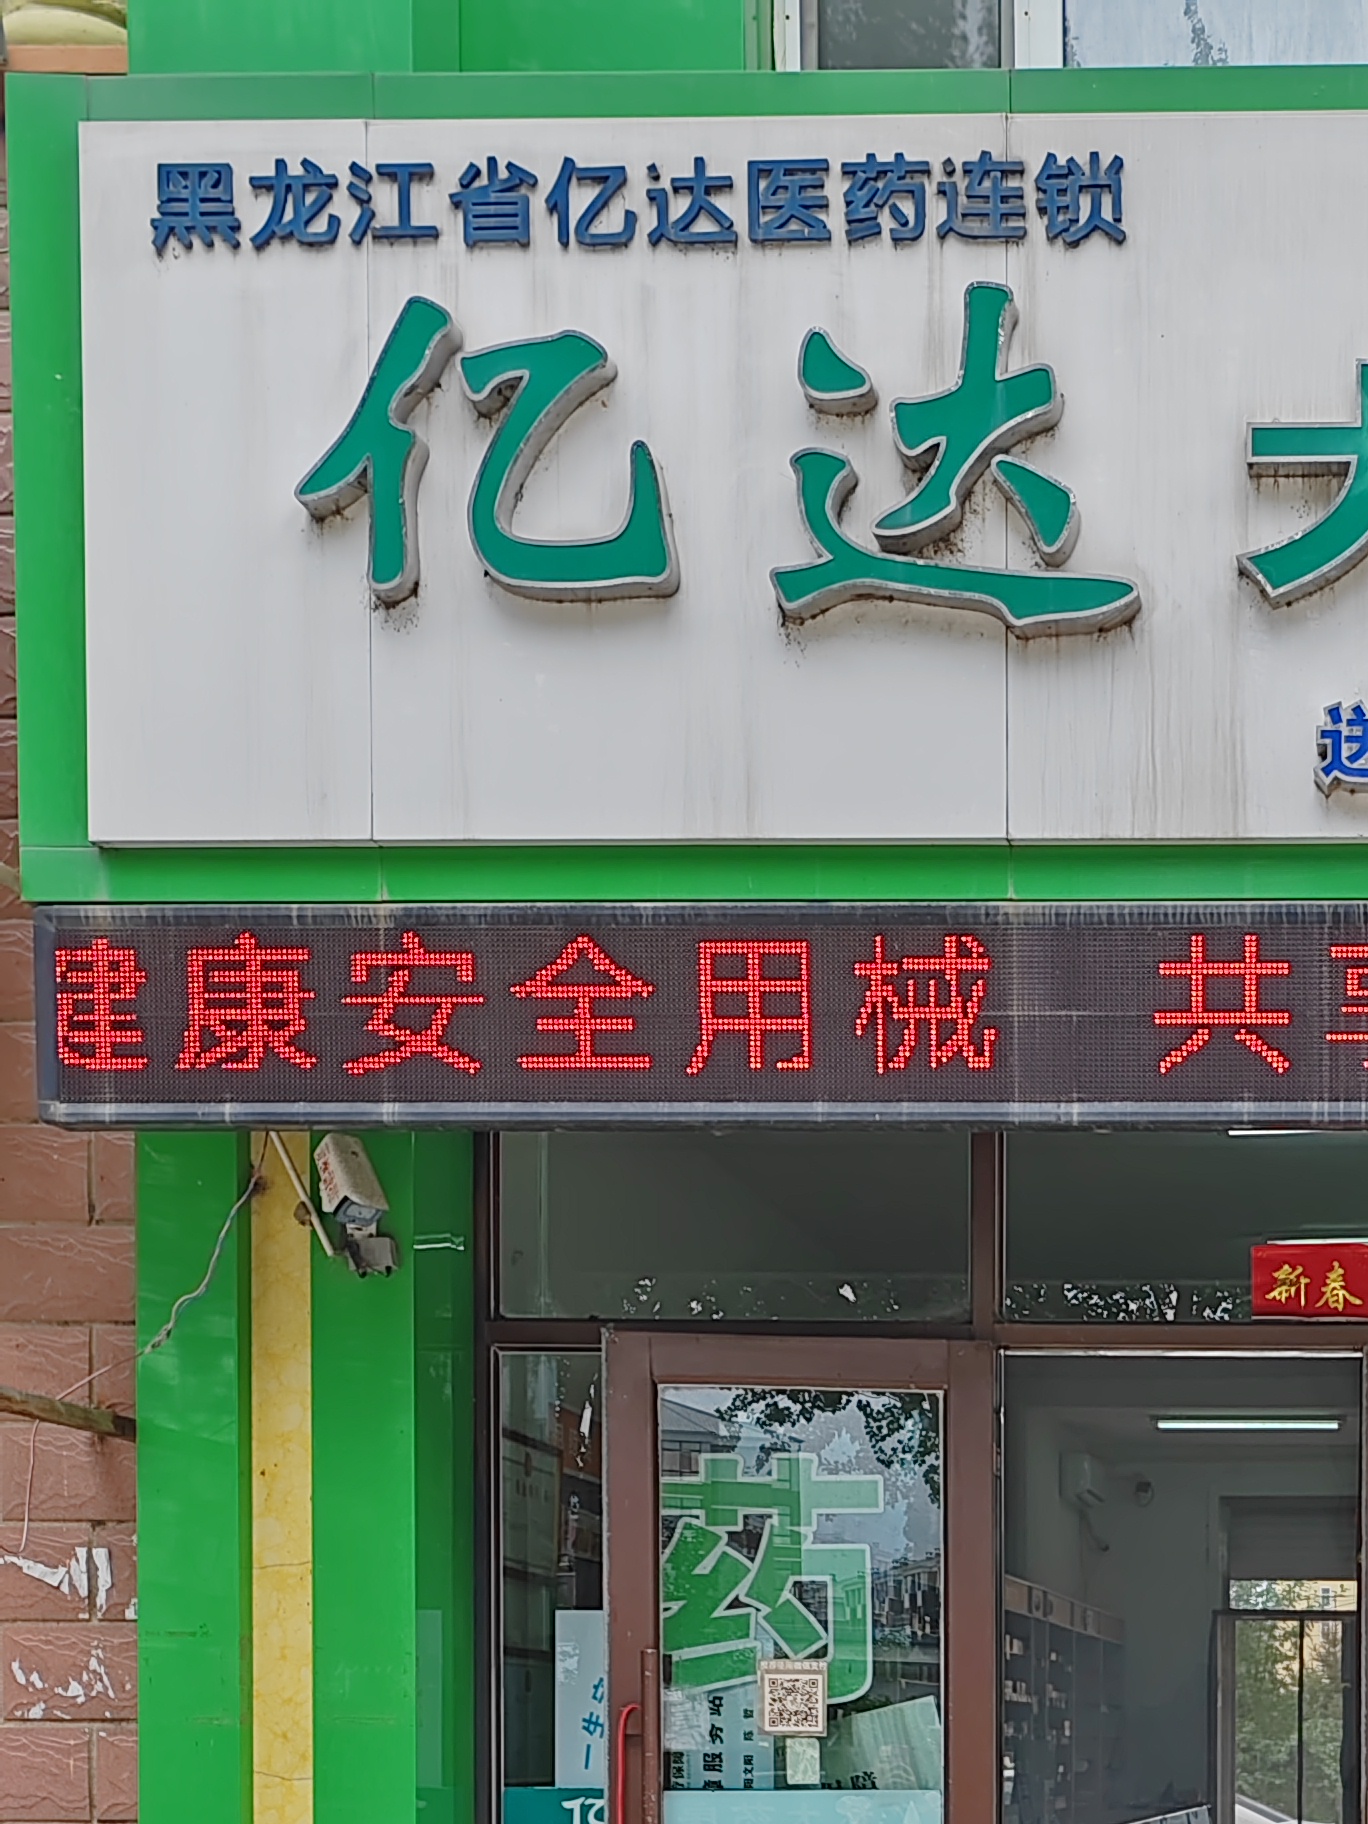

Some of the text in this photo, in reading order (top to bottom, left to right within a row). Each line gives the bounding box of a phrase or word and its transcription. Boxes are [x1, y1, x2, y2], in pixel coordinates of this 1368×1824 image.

[150, 150, 1127, 252] 黑龙江省亿达医药连锁
[662, 1453, 884, 1705] 药
